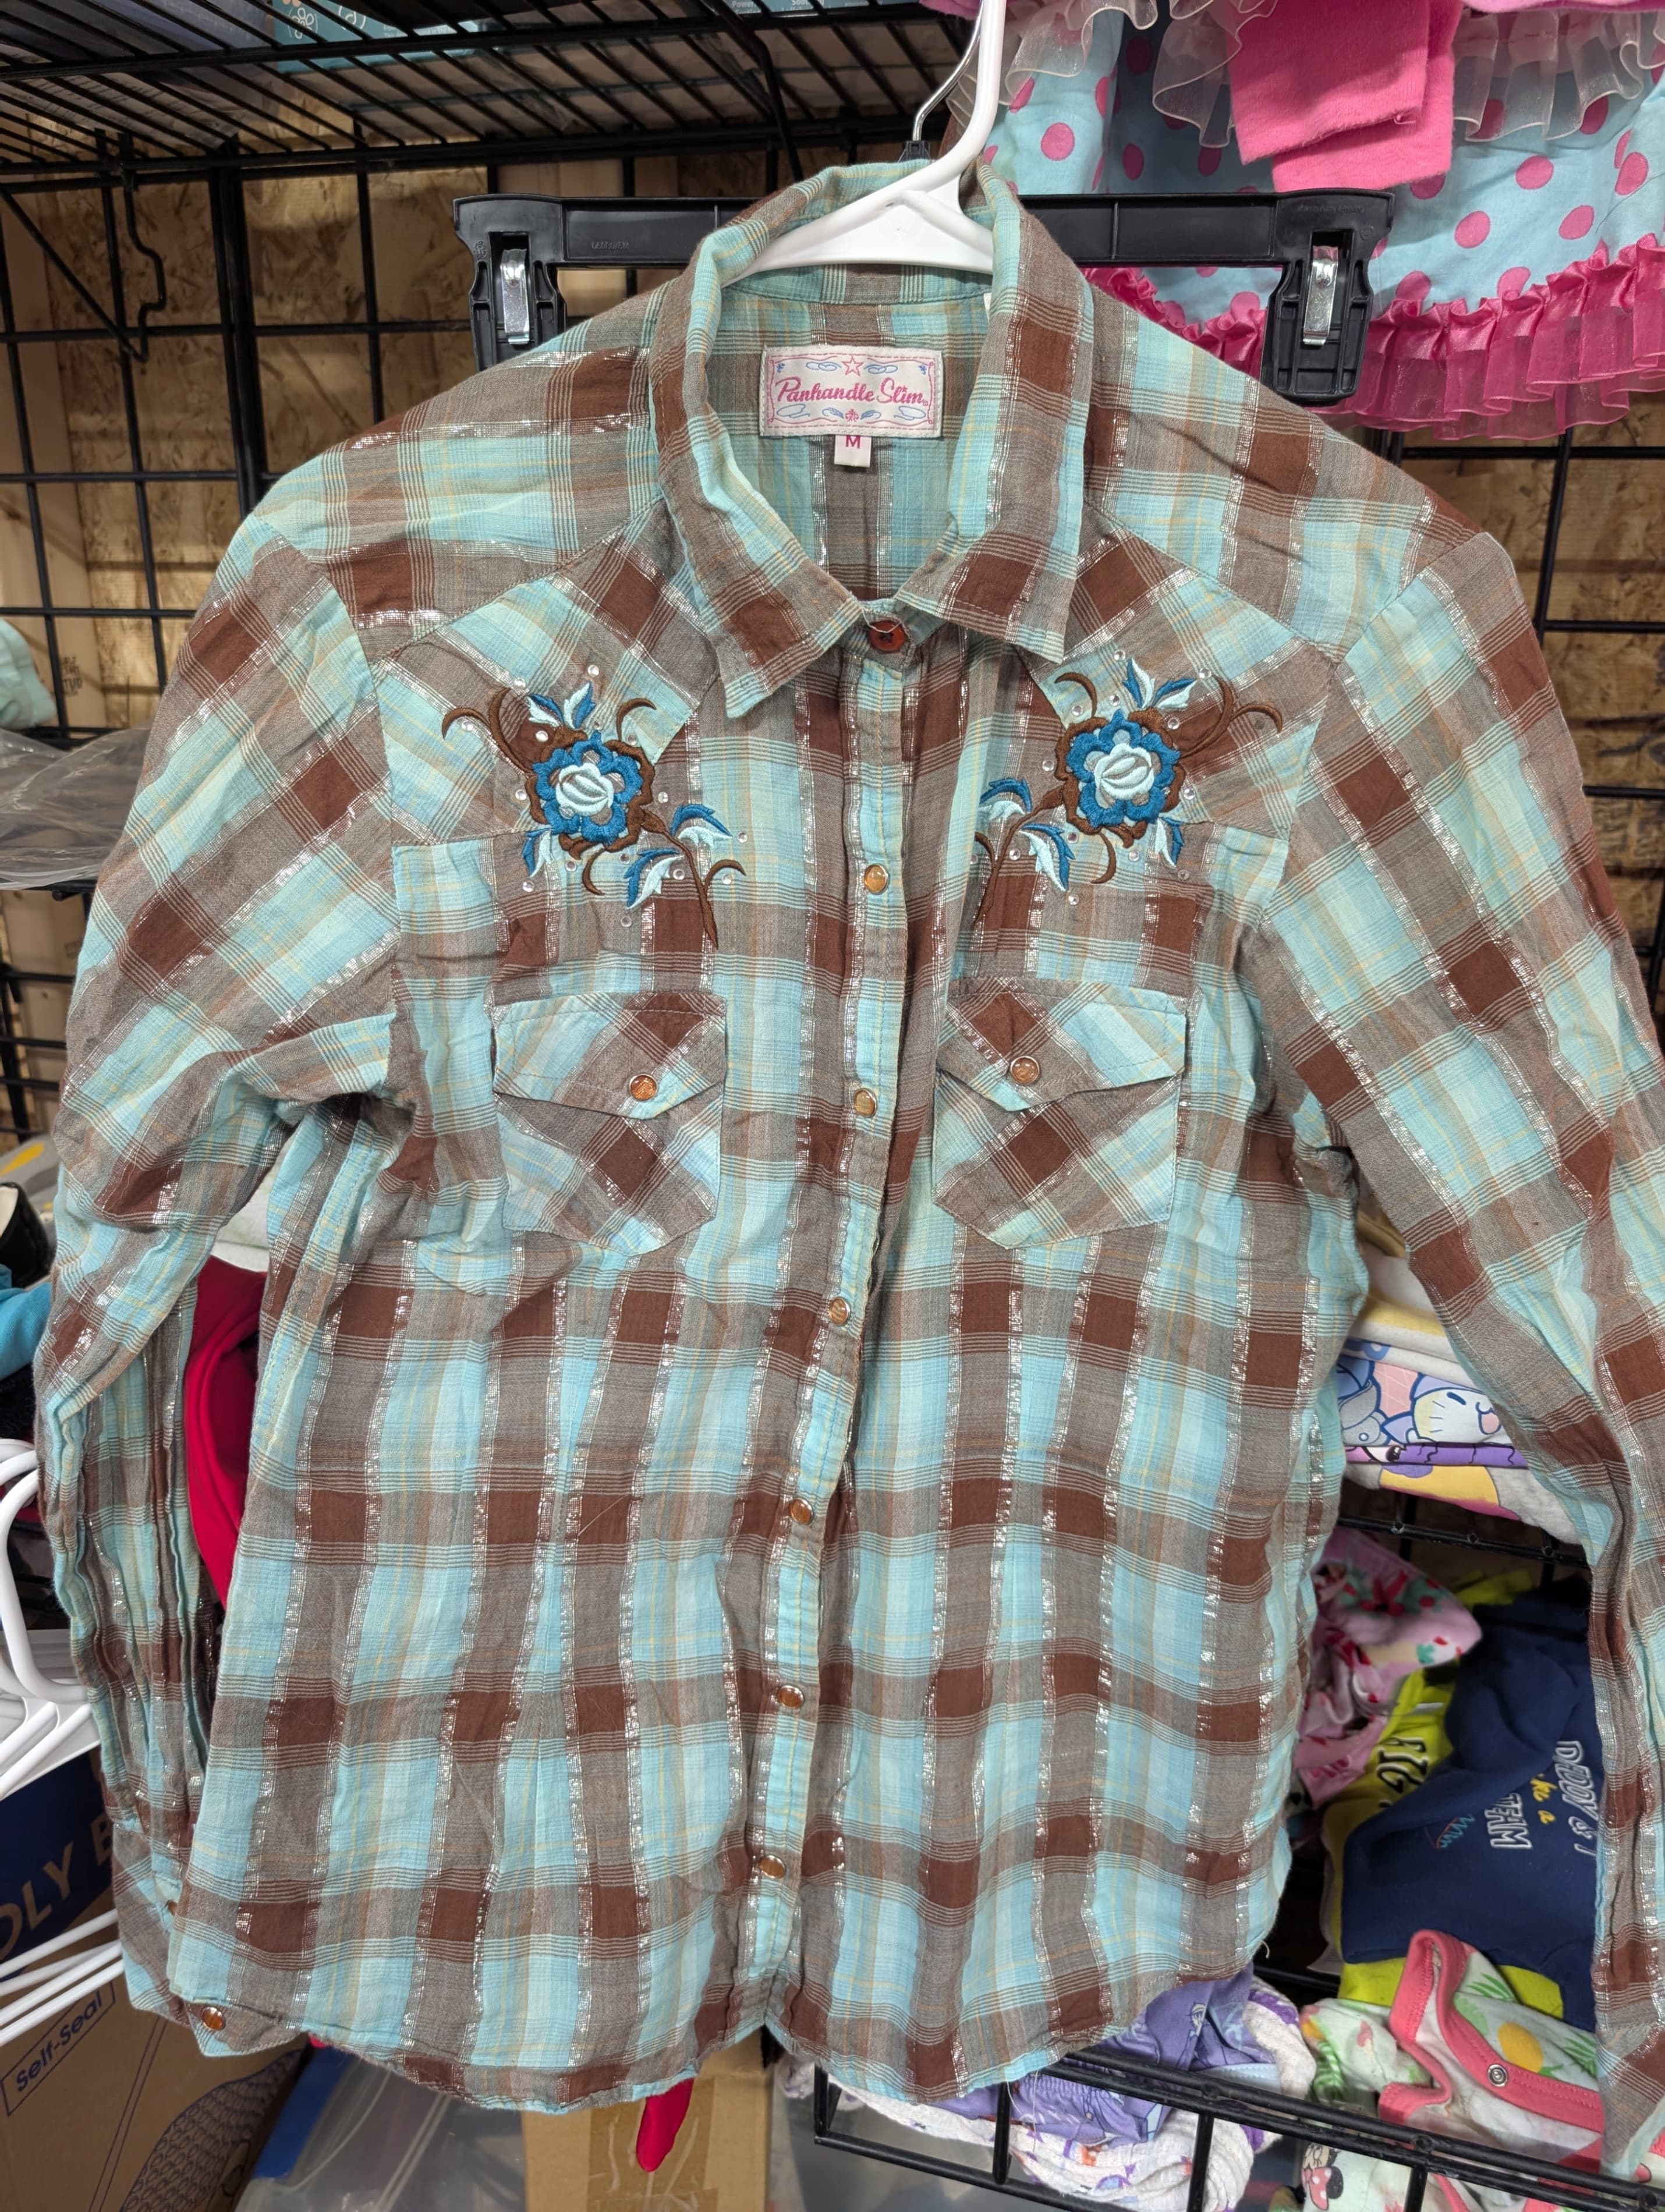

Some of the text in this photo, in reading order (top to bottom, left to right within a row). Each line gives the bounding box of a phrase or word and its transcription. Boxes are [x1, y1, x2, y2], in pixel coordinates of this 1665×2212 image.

[775, 376, 924, 403] Panhandle Slim
[846, 435, 861, 449] M
[1552, 1740, 1599, 1821] DADDY
[1485, 1792, 1533, 1851] TEAM
[16, 1990, 102, 2093] Self-Seal
